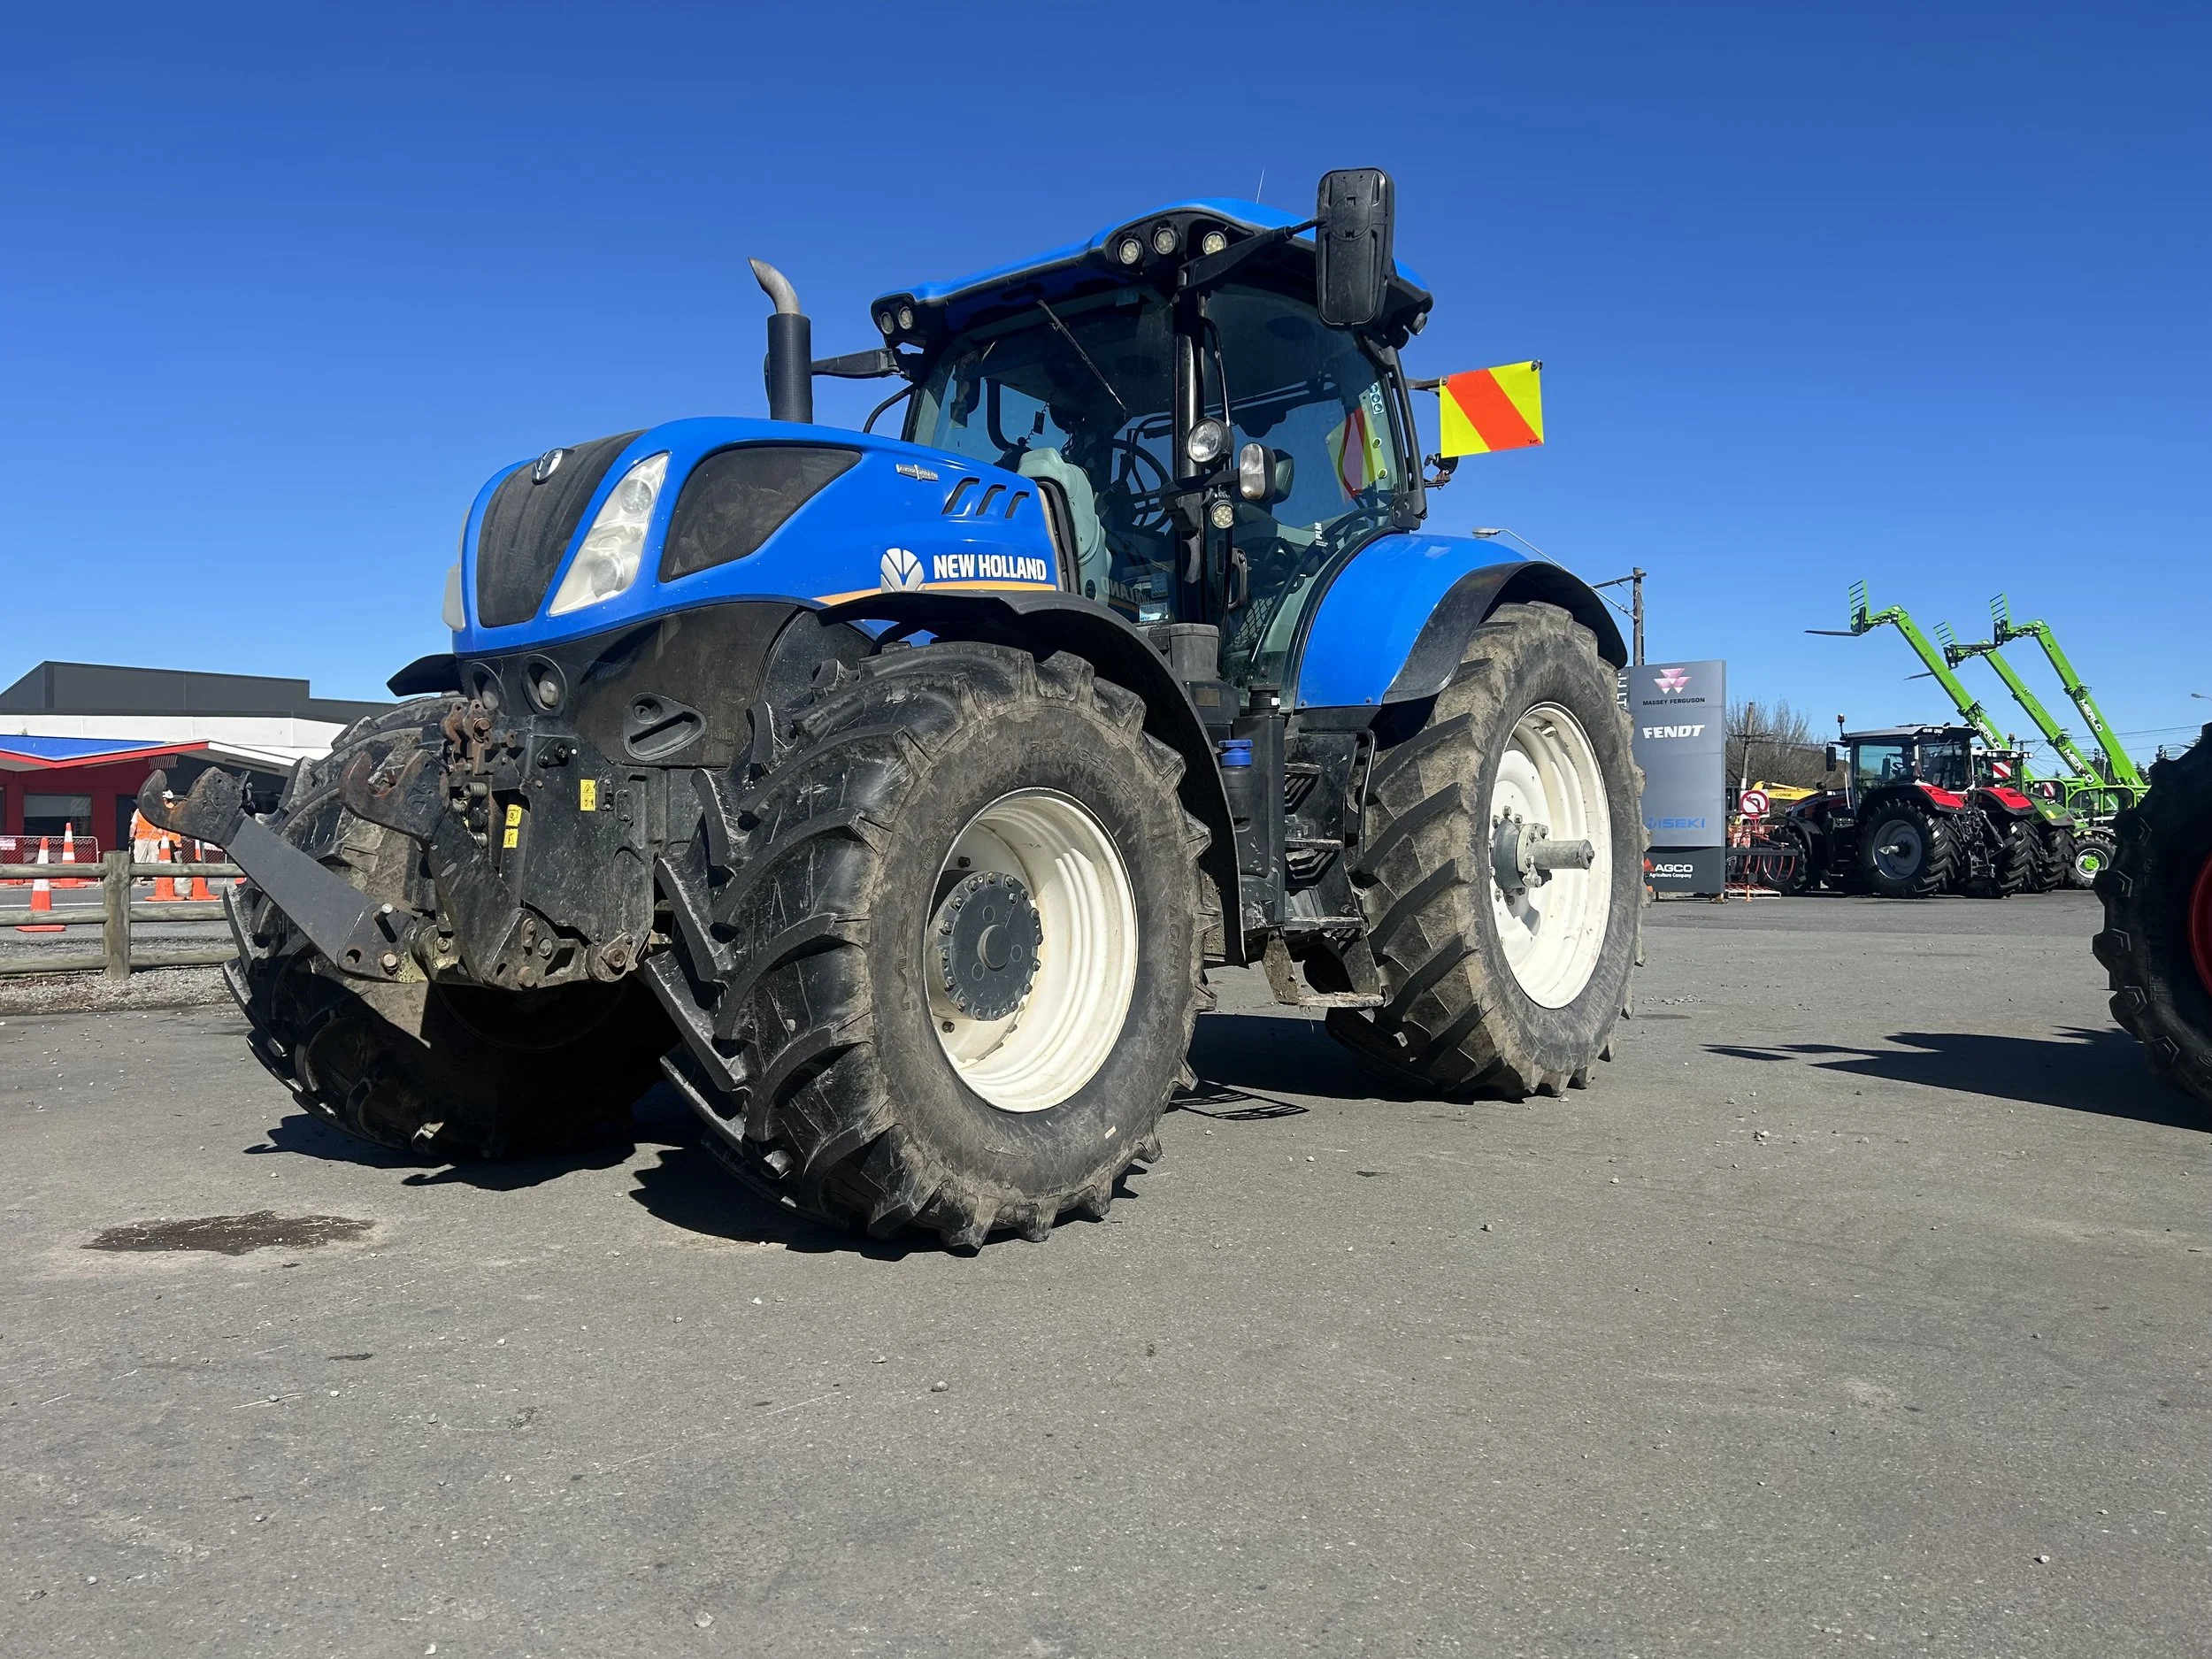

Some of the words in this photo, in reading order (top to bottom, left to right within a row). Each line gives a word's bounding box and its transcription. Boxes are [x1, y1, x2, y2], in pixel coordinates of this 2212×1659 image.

[1314, 522, 1323, 541] PLM
[933, 554, 976, 580] NEW
[978, 554, 1047, 581] HOLLAND
[1616, 692, 1627, 710] LT
[2079, 698, 2103, 733] MERLO
[1642, 724, 1706, 739] FENDT
[1976, 717, 2003, 750] MERLO
[2063, 748, 2095, 784] MERO
[1658, 818, 1706, 829] ISEKI
[1655, 864, 1694, 872] AGCO
